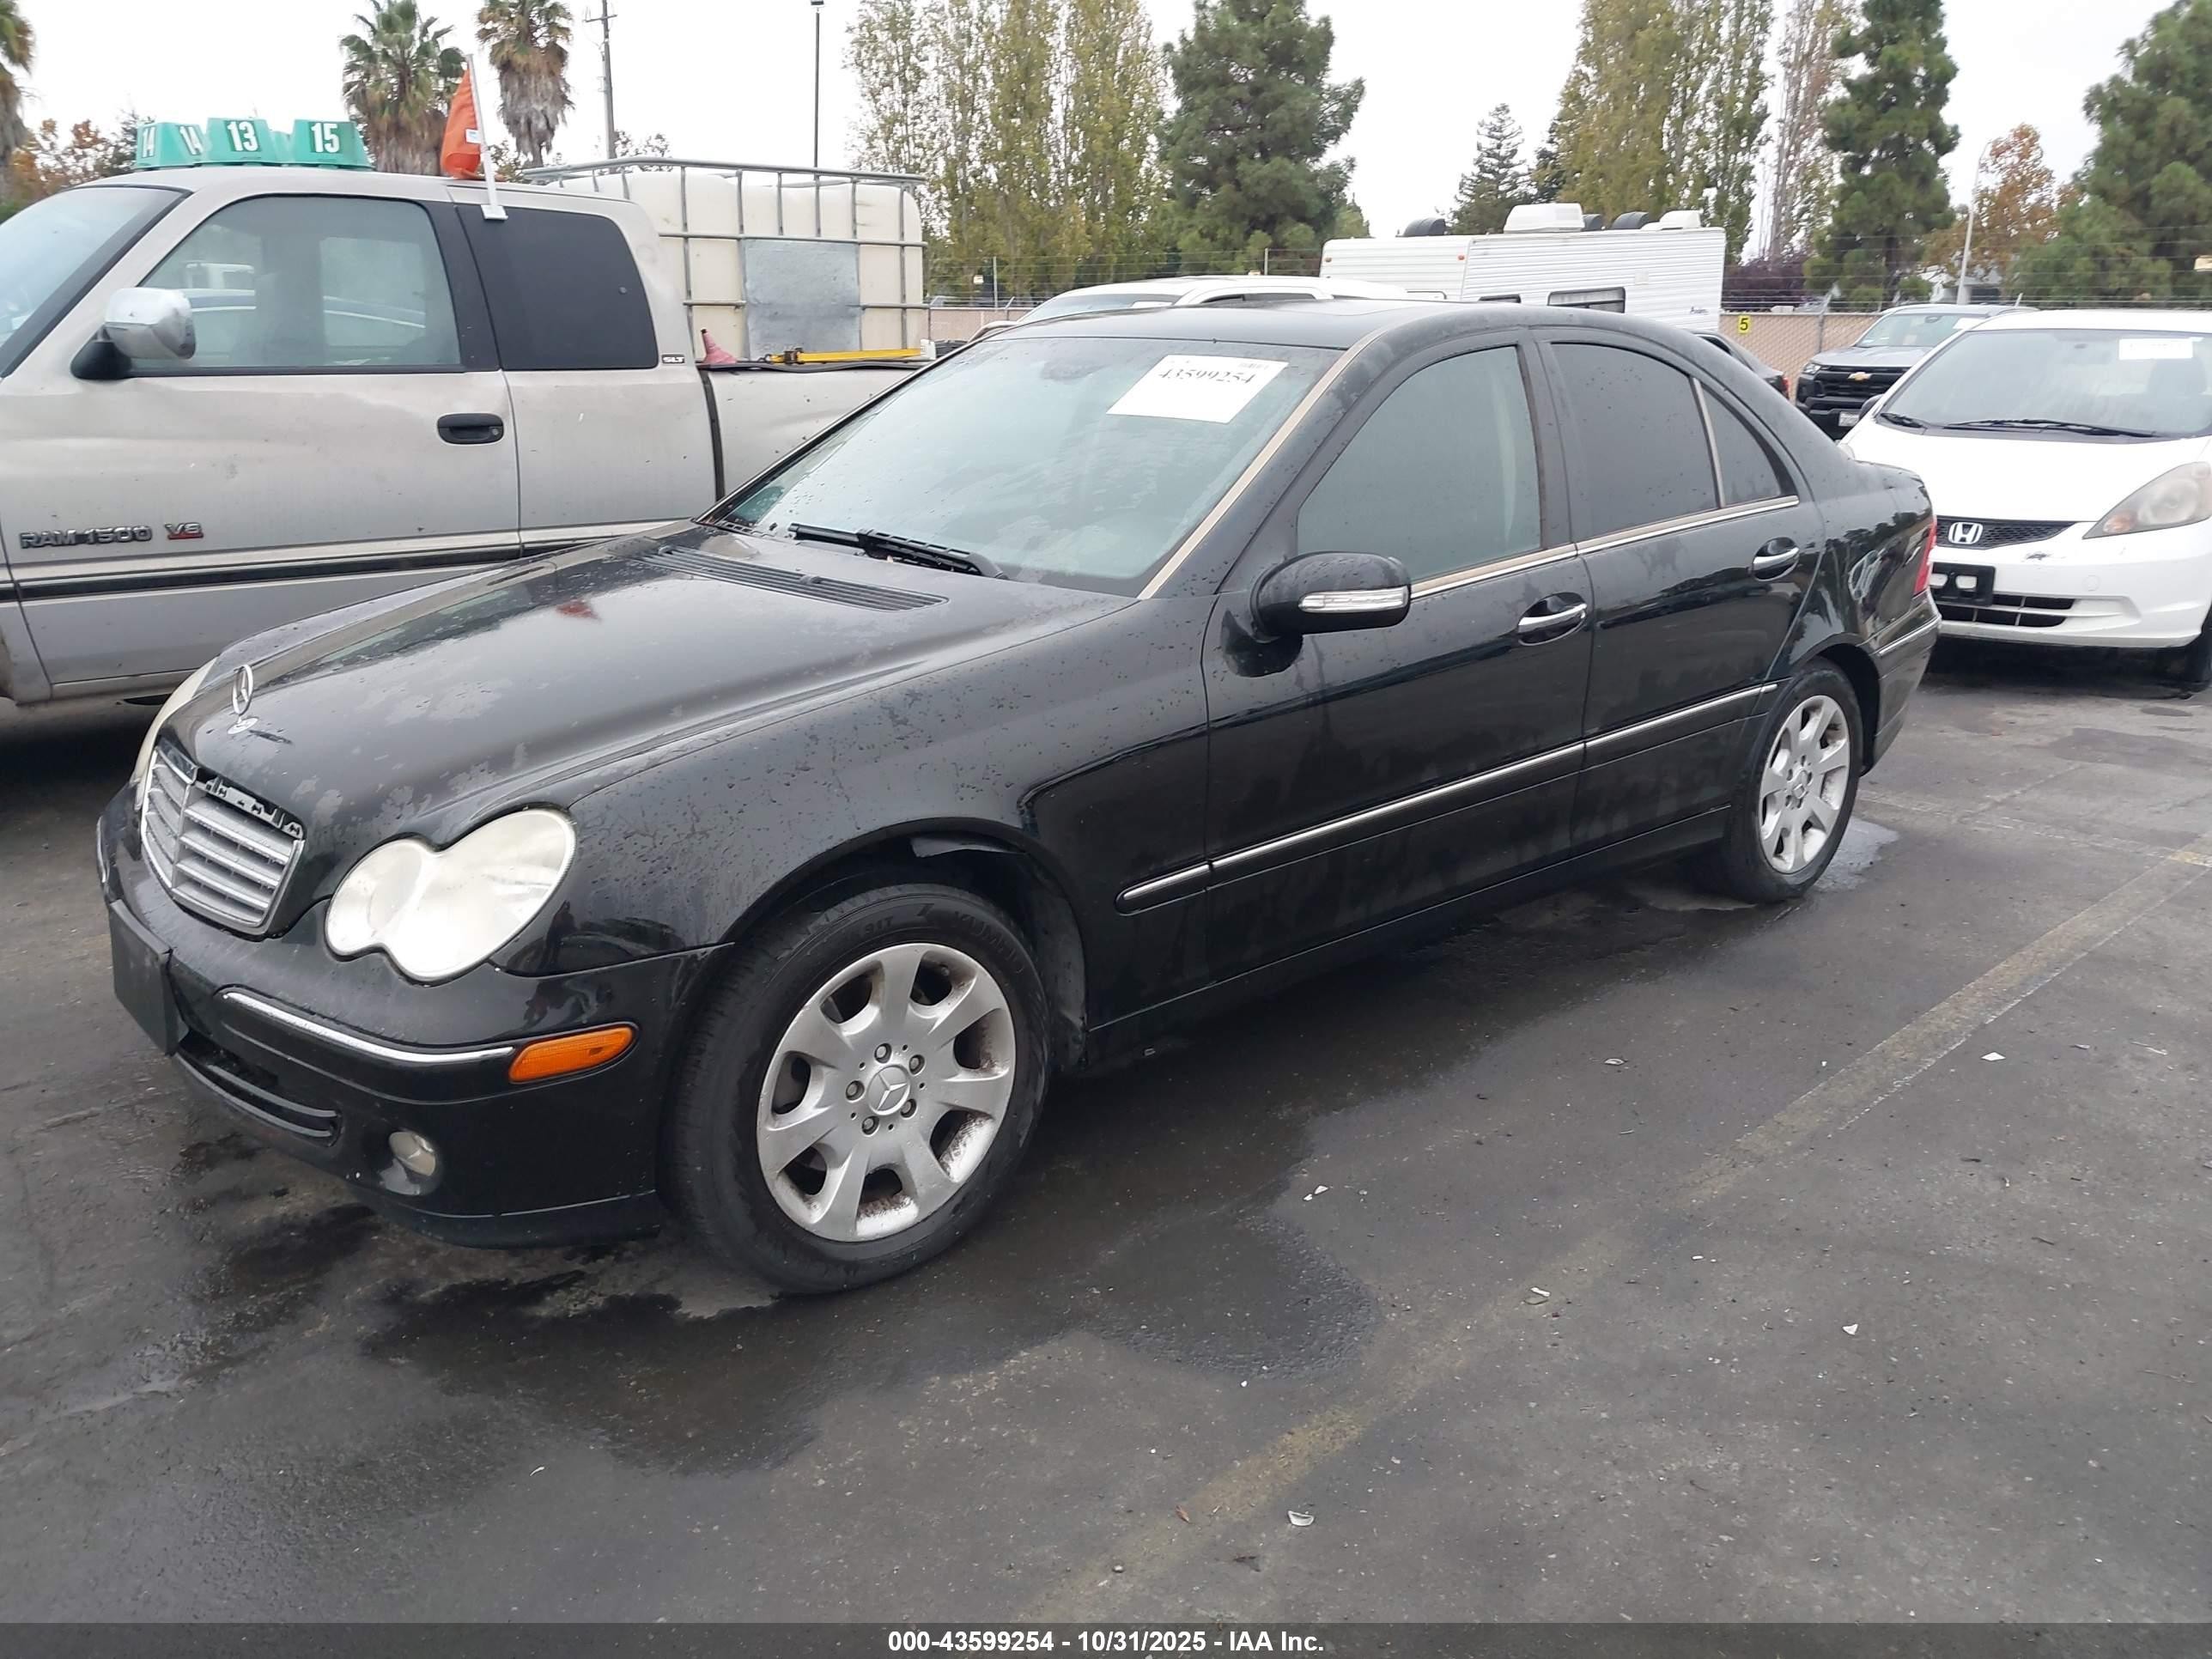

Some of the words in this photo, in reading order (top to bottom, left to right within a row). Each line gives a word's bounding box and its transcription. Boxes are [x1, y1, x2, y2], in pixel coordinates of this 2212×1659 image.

[227, 121, 258, 152] 13
[311, 123, 340, 153] 15
[1740, 318, 1748, 331] 5
[19, 529, 77, 549] RAM
[85, 526, 153, 544] 1500
[164, 522, 204, 538] V8
